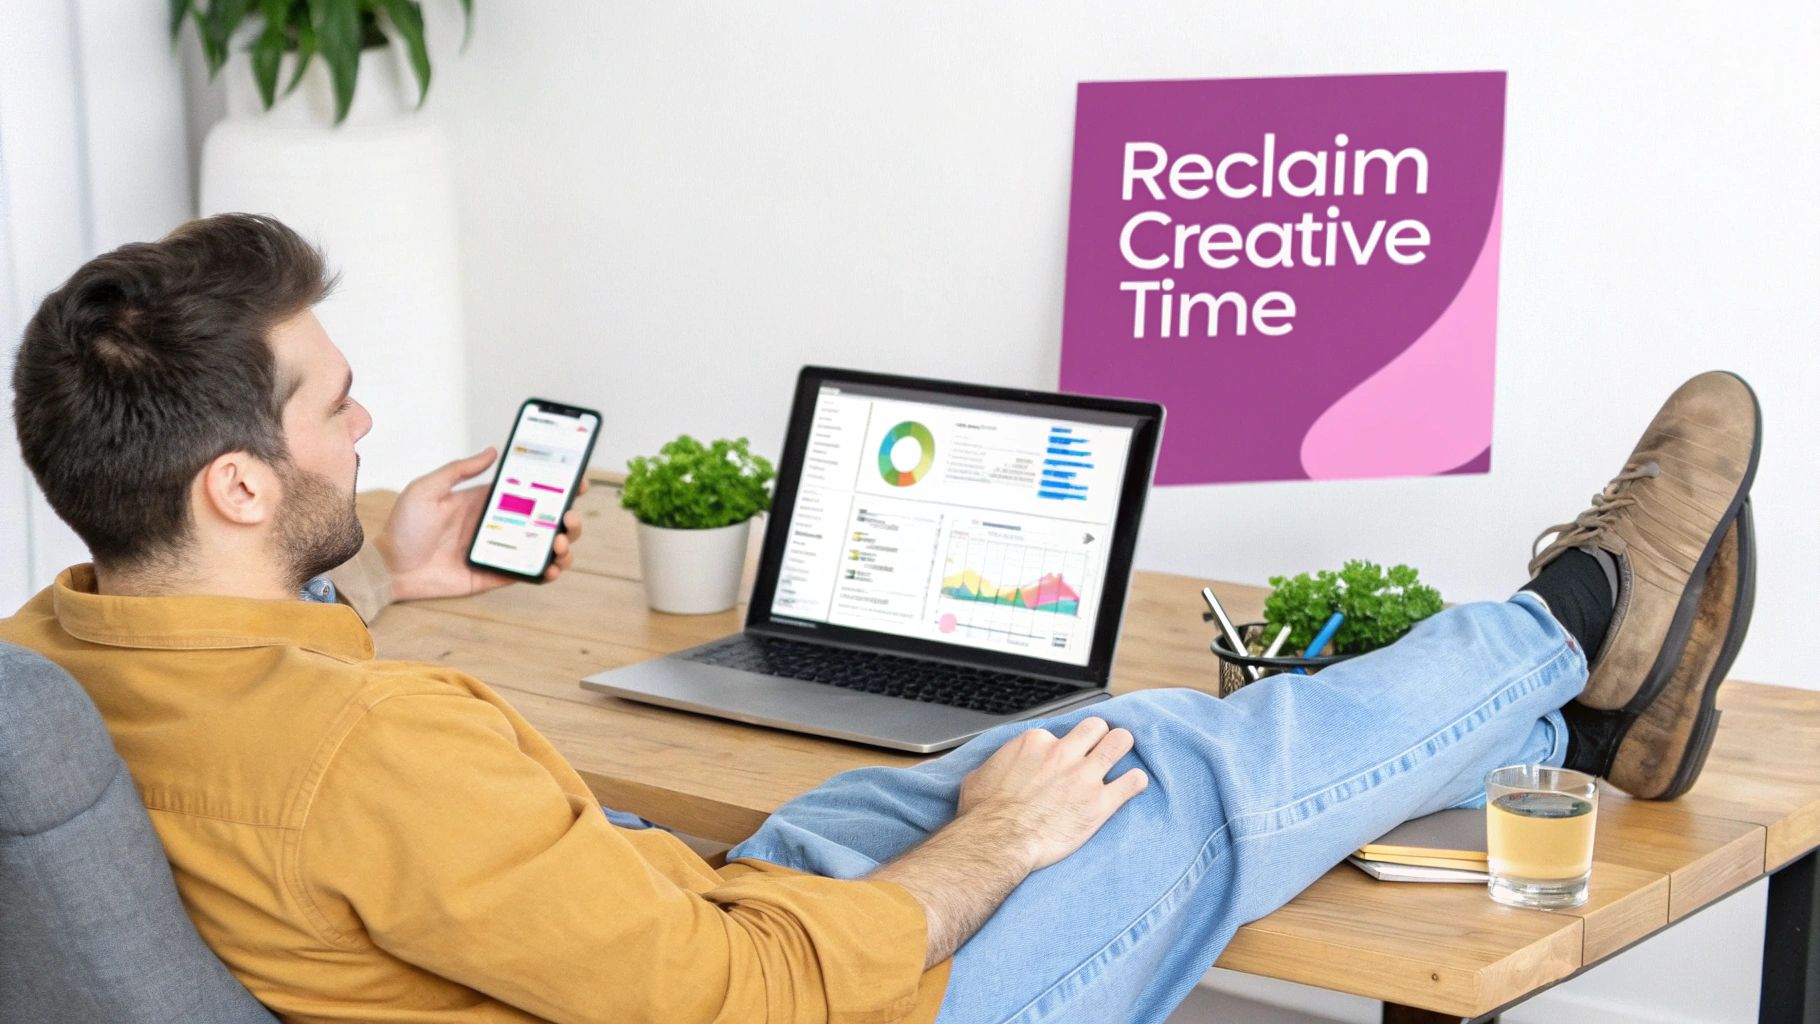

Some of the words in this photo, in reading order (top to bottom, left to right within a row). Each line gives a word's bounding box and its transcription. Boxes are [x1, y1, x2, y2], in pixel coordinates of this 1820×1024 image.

[1122, 133, 1428, 200] Reclaim
[1119, 206, 1431, 270] Creative
[1119, 278, 1296, 339] Time
